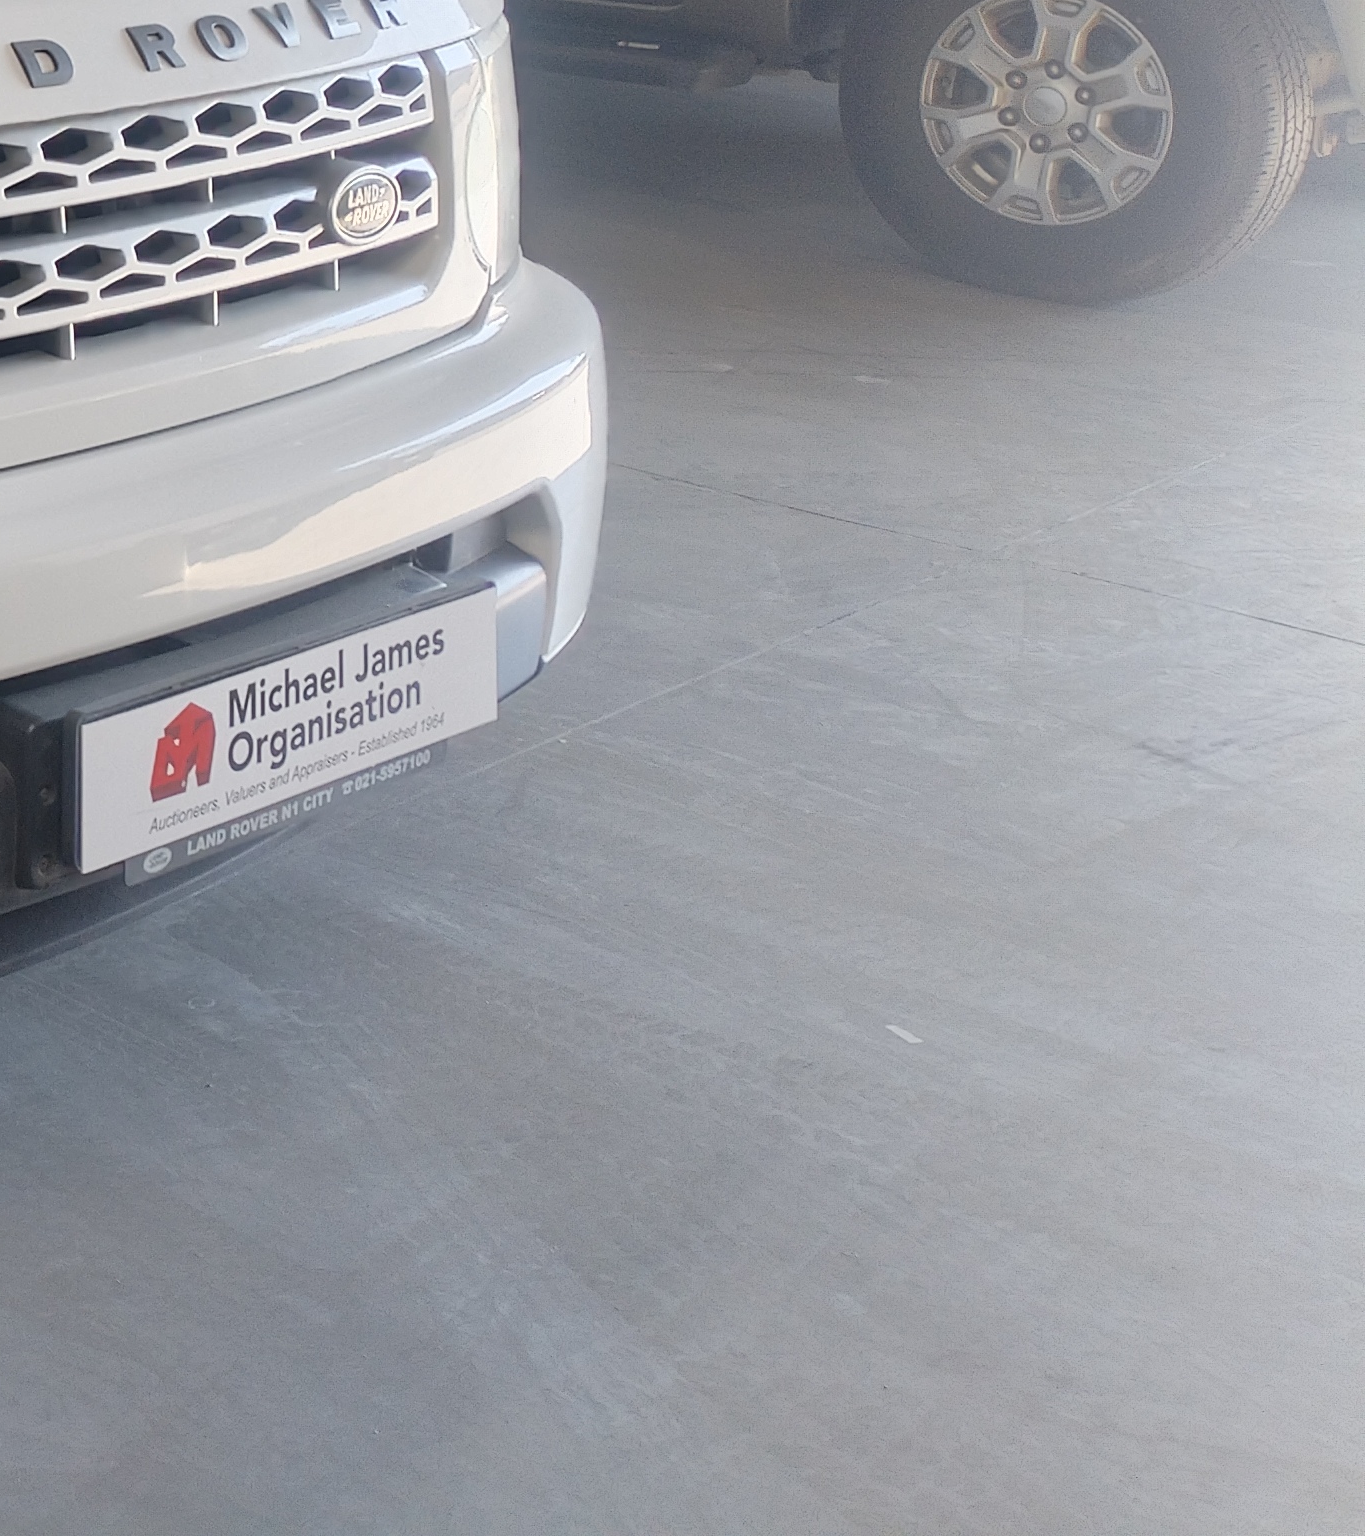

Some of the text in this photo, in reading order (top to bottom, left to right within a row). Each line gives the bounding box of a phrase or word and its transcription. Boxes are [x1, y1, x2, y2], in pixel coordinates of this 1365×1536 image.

[347, 183, 380, 209] LAND
[352, 200, 389, 226] ROVER
[229, 628, 445, 727] Michael James
[228, 678, 422, 772] Organisation
[149, 798, 220, 835] Auctioneers,
[225, 780, 267, 806] Valuers
[268, 768, 291, 791] and
[291, 750, 349, 782] Appraisers
[358, 721, 418, 756] Established
[420, 712, 445, 733] 1964
[187, 828, 227, 856] LAND
[230, 809, 279, 840] ROVER
[281, 800, 299, 822] N1
[302, 787, 334, 812] CITY
